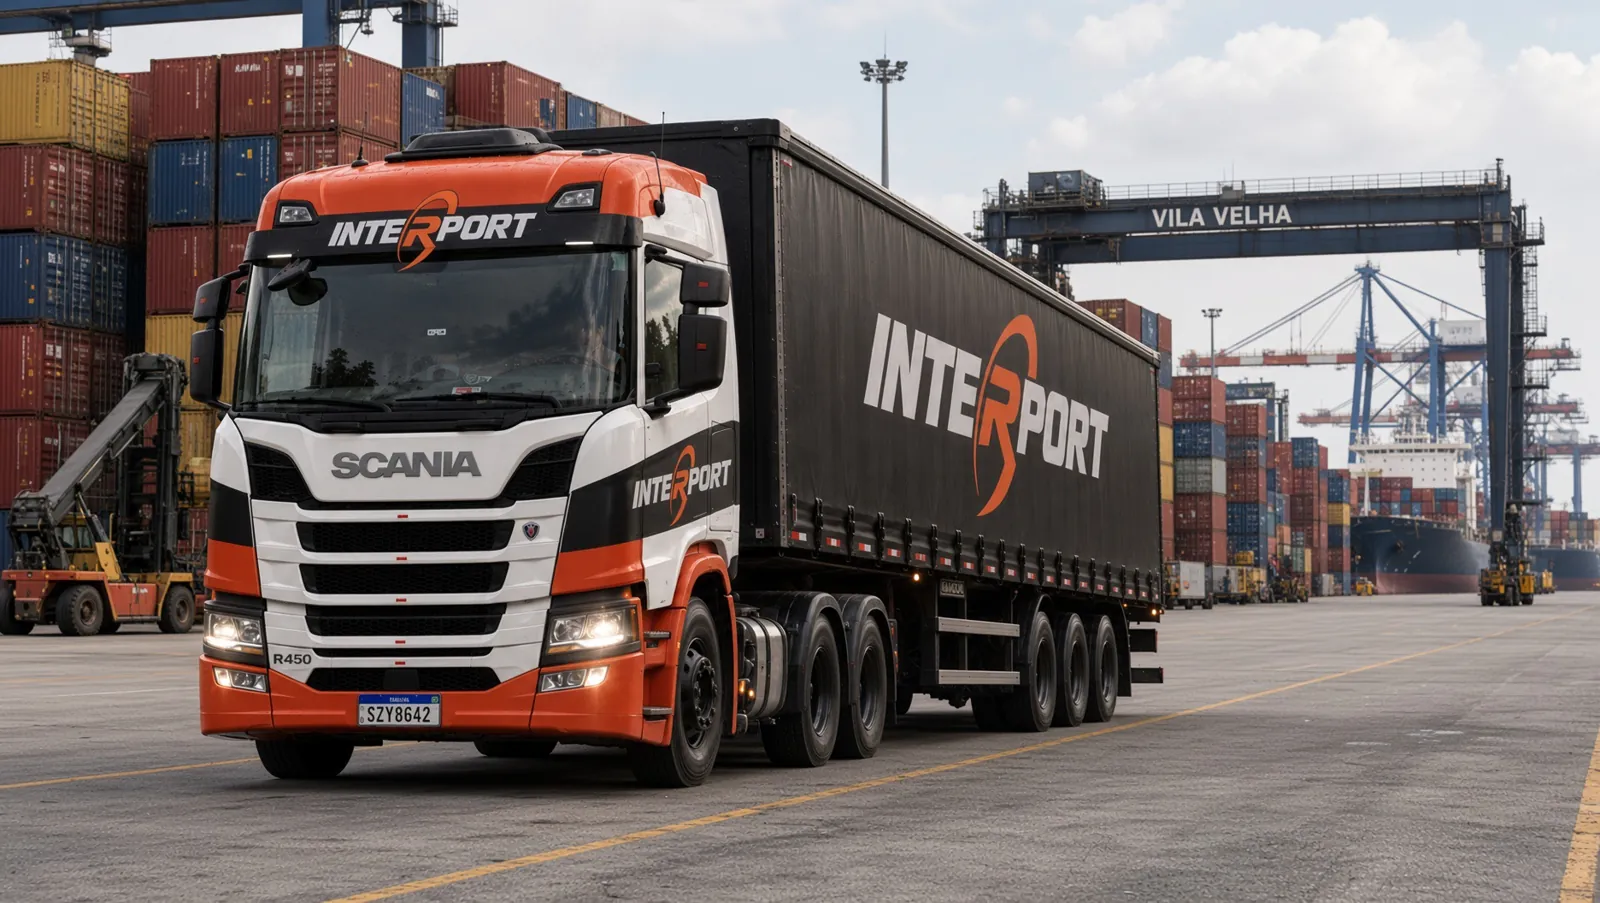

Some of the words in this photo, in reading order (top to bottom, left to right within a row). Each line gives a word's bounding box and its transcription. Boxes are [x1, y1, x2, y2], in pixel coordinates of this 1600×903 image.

[1152, 207, 1205, 228] VILA
[1213, 204, 1292, 226] VELHA
[328, 212, 538, 272] INTERPORT
[863, 313, 1110, 516] INTERPORT
[331, 450, 482, 479] SCANIA
[632, 459, 732, 526] INTERPORT
[273, 653, 312, 665] R450
[367, 706, 431, 723] SZY8642
